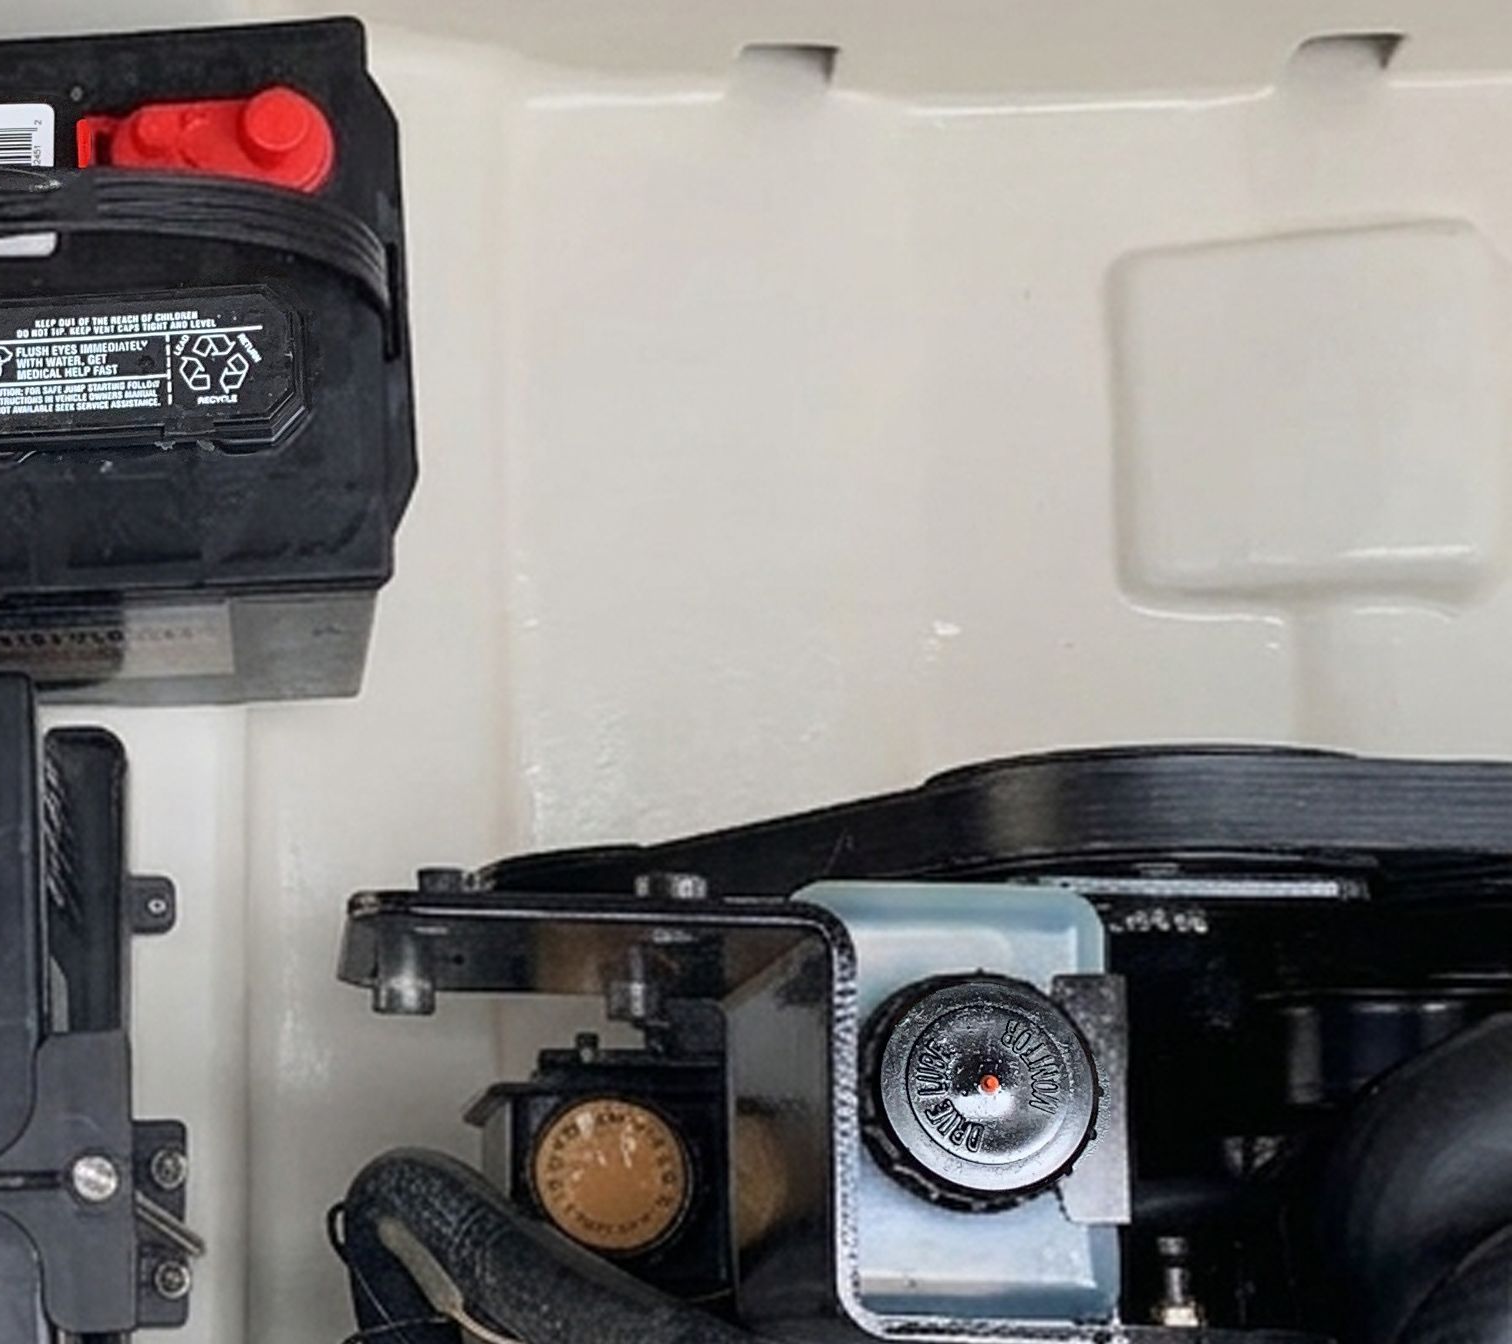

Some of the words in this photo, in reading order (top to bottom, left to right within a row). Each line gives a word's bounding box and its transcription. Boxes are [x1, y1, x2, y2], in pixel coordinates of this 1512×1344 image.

[35, 320, 56, 328] KEEP
[59, 319, 76, 327] OUT
[79, 318, 89, 326] OF
[91, 317, 108, 325] THE
[110, 315, 139, 324] REACH
[142, 314, 153, 323] OF
[155, 311, 198, 322] CHILDREN
[17, 329, 29, 338] DO
[31, 328, 48, 337] NOT
[70, 325, 91, 335] KEEP
[94, 325, 115, 334] VENT
[117, 324, 140, 333] CAPS
[142, 322, 168, 331] TIGHT
[171, 321, 188, 330] AND
[190, 319, 216, 328] LEVEL
[16, 347, 49, 357] FLUSH
[52, 345, 78, 356] EYES
[80, 340, 148, 354] IMMEDIATELY
[174, 335, 190, 355] LEAD
[237, 334, 261, 362] RETURN
[17, 358, 44, 368] WITH
[87, 355, 107, 365] GET
[17, 368, 62, 380] MEDICAL
[65, 367, 91, 378] HELP
[94, 365, 118, 376] FAST
[25, 387, 40, 396] FOR
[42, 386, 62, 394] SAFE
[64, 384, 85, 394] JUMP
[88, 382, 124, 392] STARTING
[127, 380, 160, 390] FOLLOW
[45, 395, 53, 404] IN
[55, 393, 87, 403] VEHICLE
[89, 391, 122, 401] OWNERS
[124, 389, 158, 399] MANUAL
[12, 403, 53, 413] AVAILABLE
[55, 402, 74, 411] SEEK
[76, 401, 109, 410] SERVICE
[111, 399, 161, 409] ASSISTANCE.
[197, 395, 237, 404] RECYCLE
[917, 1038, 956, 1096] LUBE
[1000, 1020, 1059, 1114] MONITOR
[925, 1099, 984, 1152] DRIVE
